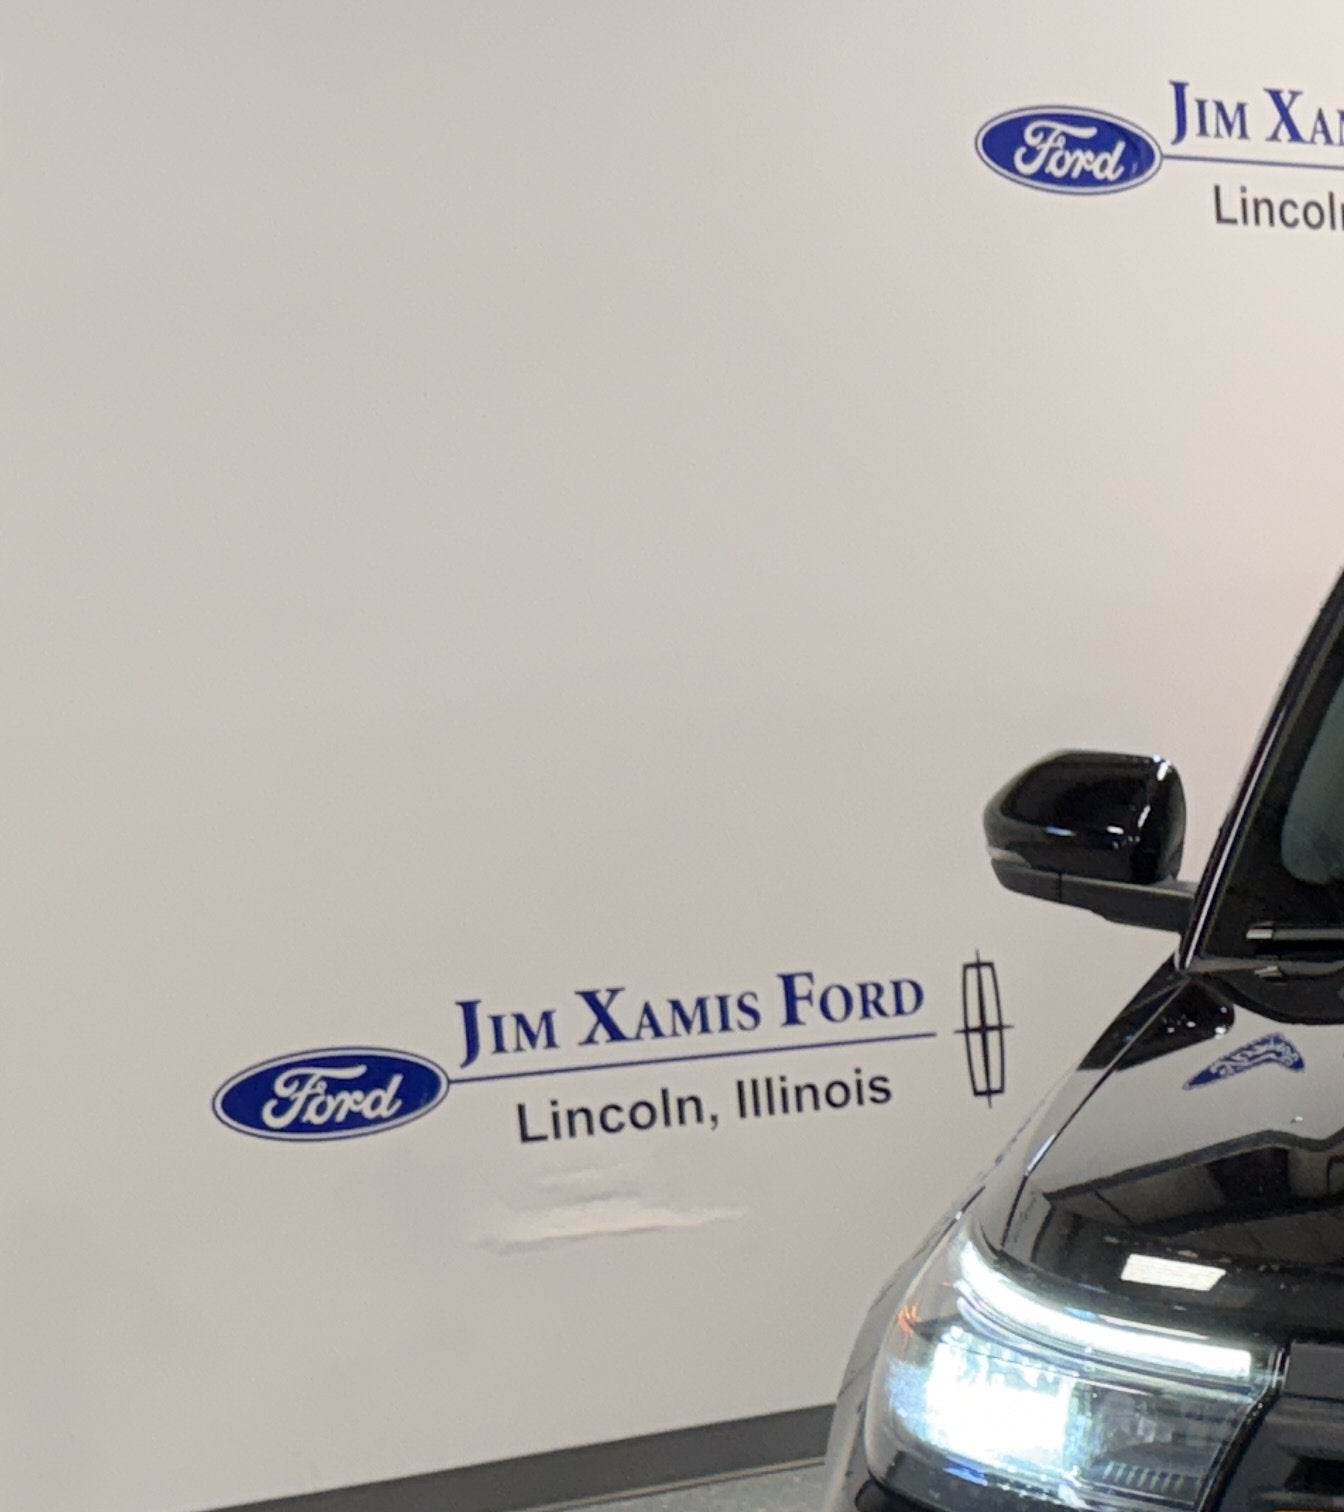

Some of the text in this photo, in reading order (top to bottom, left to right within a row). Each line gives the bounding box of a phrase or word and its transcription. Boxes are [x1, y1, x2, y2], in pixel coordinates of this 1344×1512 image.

[1169, 80, 1250, 145] JIM
[1014, 119, 1125, 182] Ford
[455, 972, 924, 1067] JIM XAMIS FORD
[262, 1064, 402, 1129] Ford
[517, 1068, 892, 1144] Lincoln, Illinois
